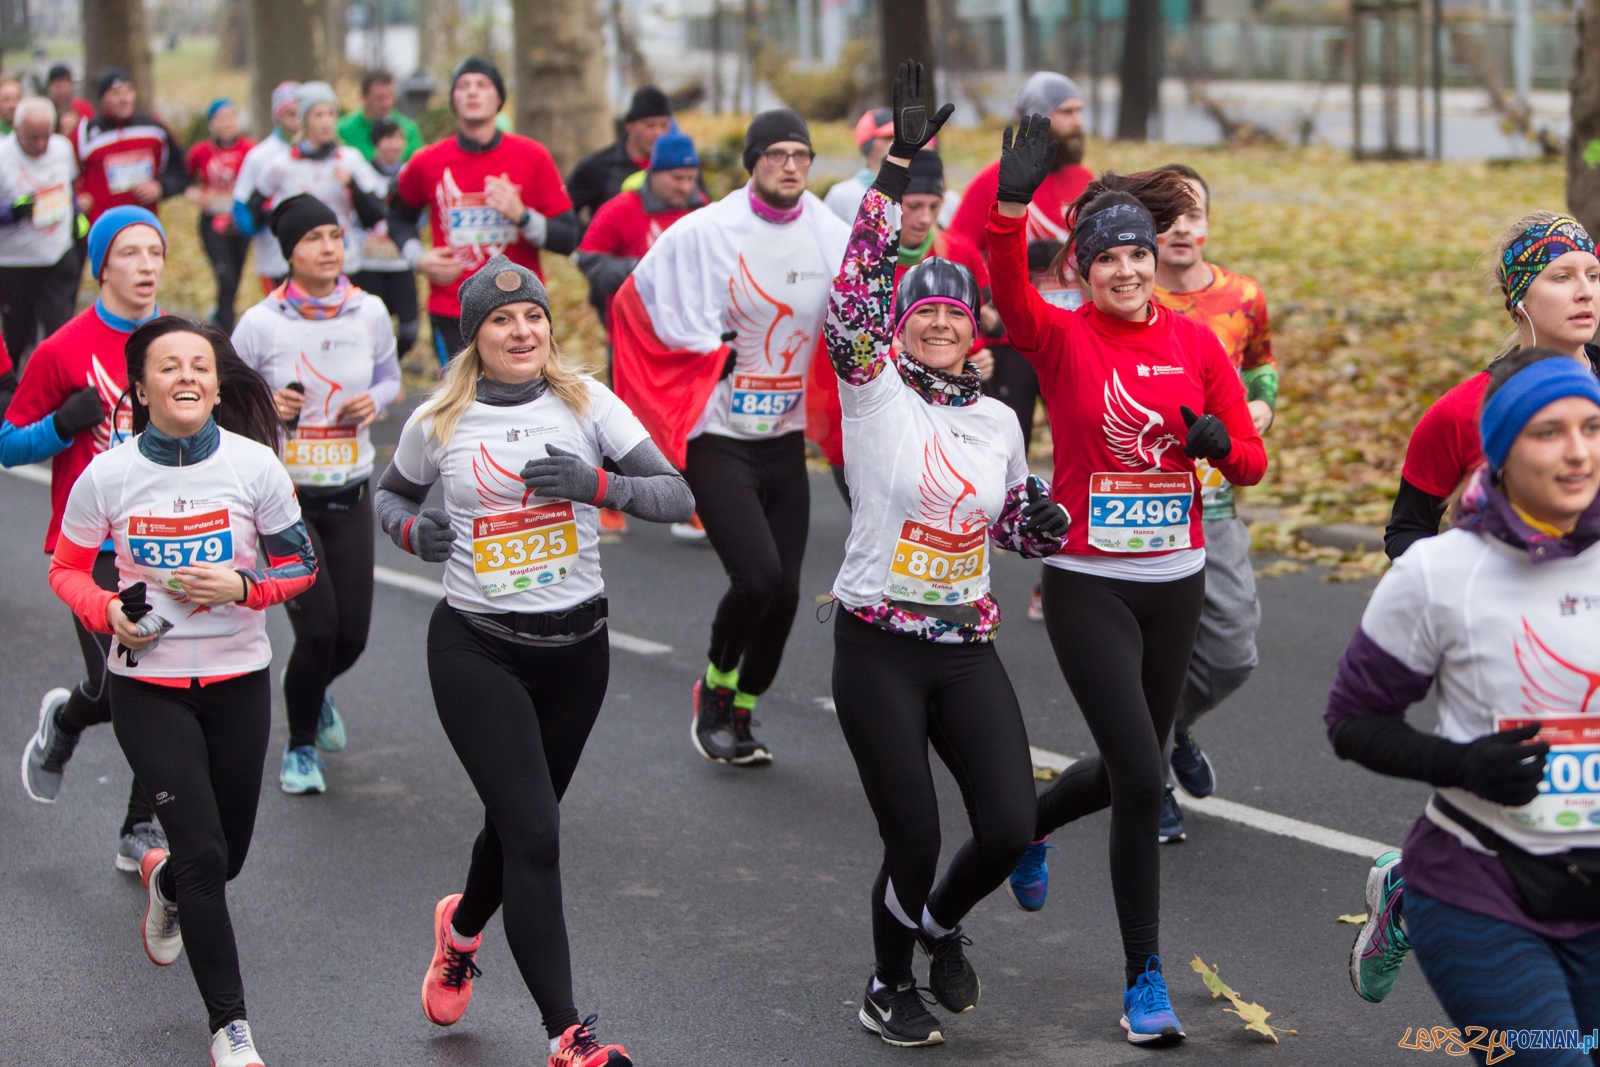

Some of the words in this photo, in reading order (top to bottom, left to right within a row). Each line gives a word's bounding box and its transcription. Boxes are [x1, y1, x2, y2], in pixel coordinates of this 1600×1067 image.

[1152, 365, 1158, 375] 1
[742, 393, 797, 414] 8457
[524, 429, 530, 438] 1
[962, 434, 968, 444] 1
[296, 443, 353, 465] 5869
[1114, 480, 1120, 490] 1
[189, 500, 194, 509] 1
[524, 510, 567, 524] RunPoland.org
[1093, 507, 1101, 516] E
[1105, 499, 1183, 525] 2496
[149, 524, 154, 532] 1
[184, 518, 224, 532] RunPoland.org
[489, 522, 496, 532] 1
[132, 548, 140, 556] E
[143, 537, 223, 567] 3579
[476, 552, 483, 562] D
[485, 528, 568, 568] 3325
[510, 564, 548, 576] Magdalena
[896, 553, 905, 562] D
[908, 550, 979, 580] 8059
